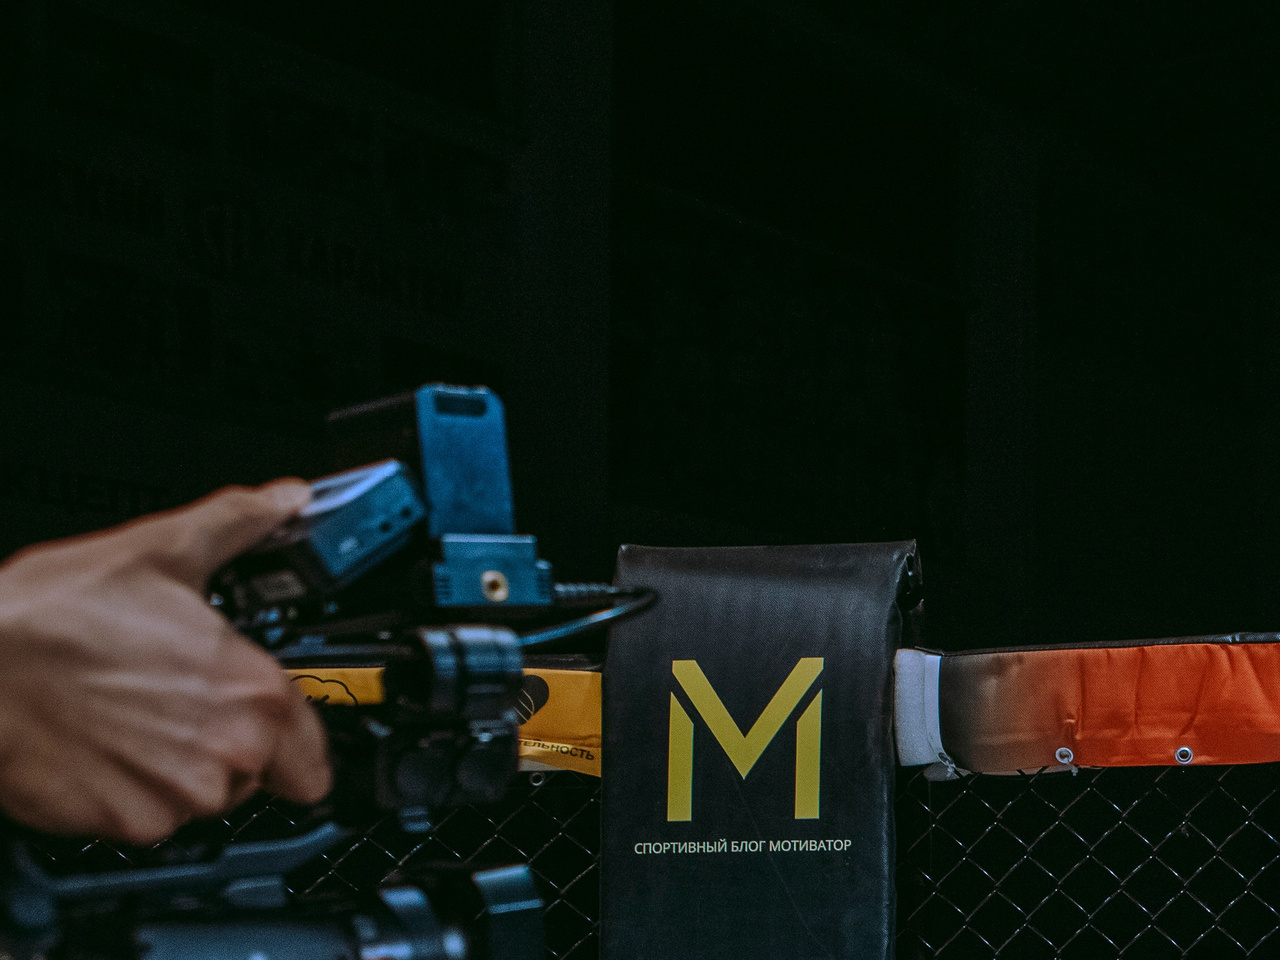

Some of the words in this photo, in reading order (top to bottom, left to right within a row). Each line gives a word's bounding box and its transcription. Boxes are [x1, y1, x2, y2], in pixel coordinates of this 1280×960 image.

[634, 839, 728, 854] СПОРТИВНЫЙ
[731, 840, 766, 852] БЛОГ
[769, 839, 852, 852] МОТИВАТОР
